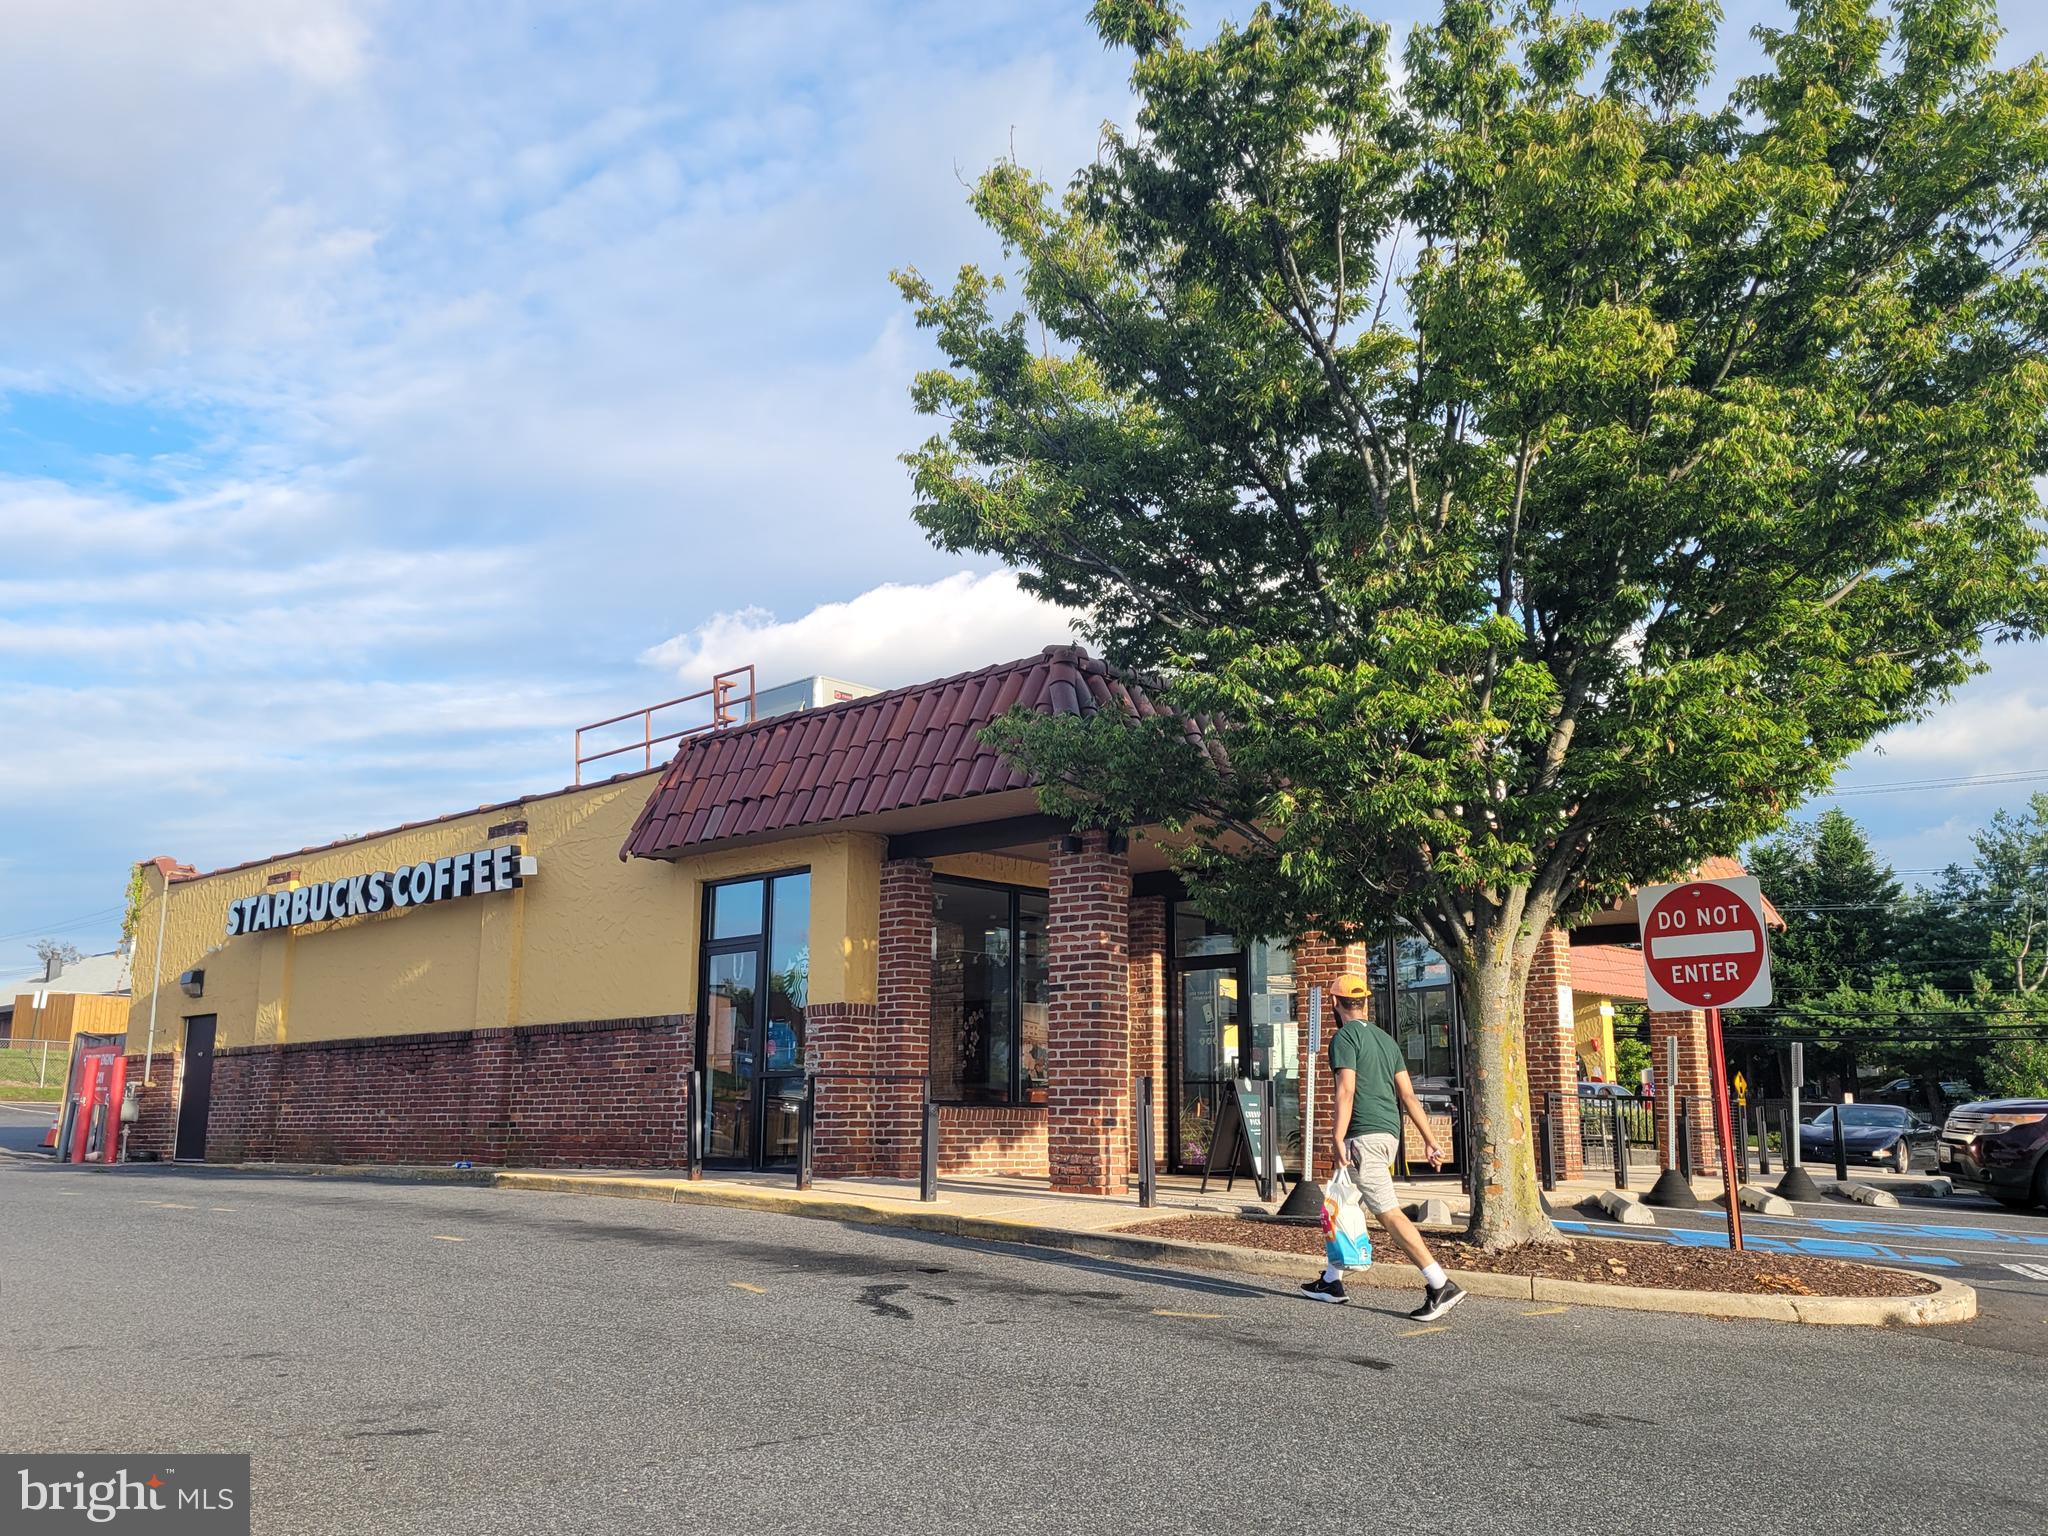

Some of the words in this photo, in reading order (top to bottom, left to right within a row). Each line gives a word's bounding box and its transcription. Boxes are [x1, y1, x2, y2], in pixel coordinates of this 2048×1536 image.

[225, 871, 389, 936] STARBUCKS
[392, 845, 520, 907] COFFEE
[1657, 909, 1686, 930] DO
[1696, 904, 1740, 927] NOT
[1671, 961, 1740, 984] ENTER
